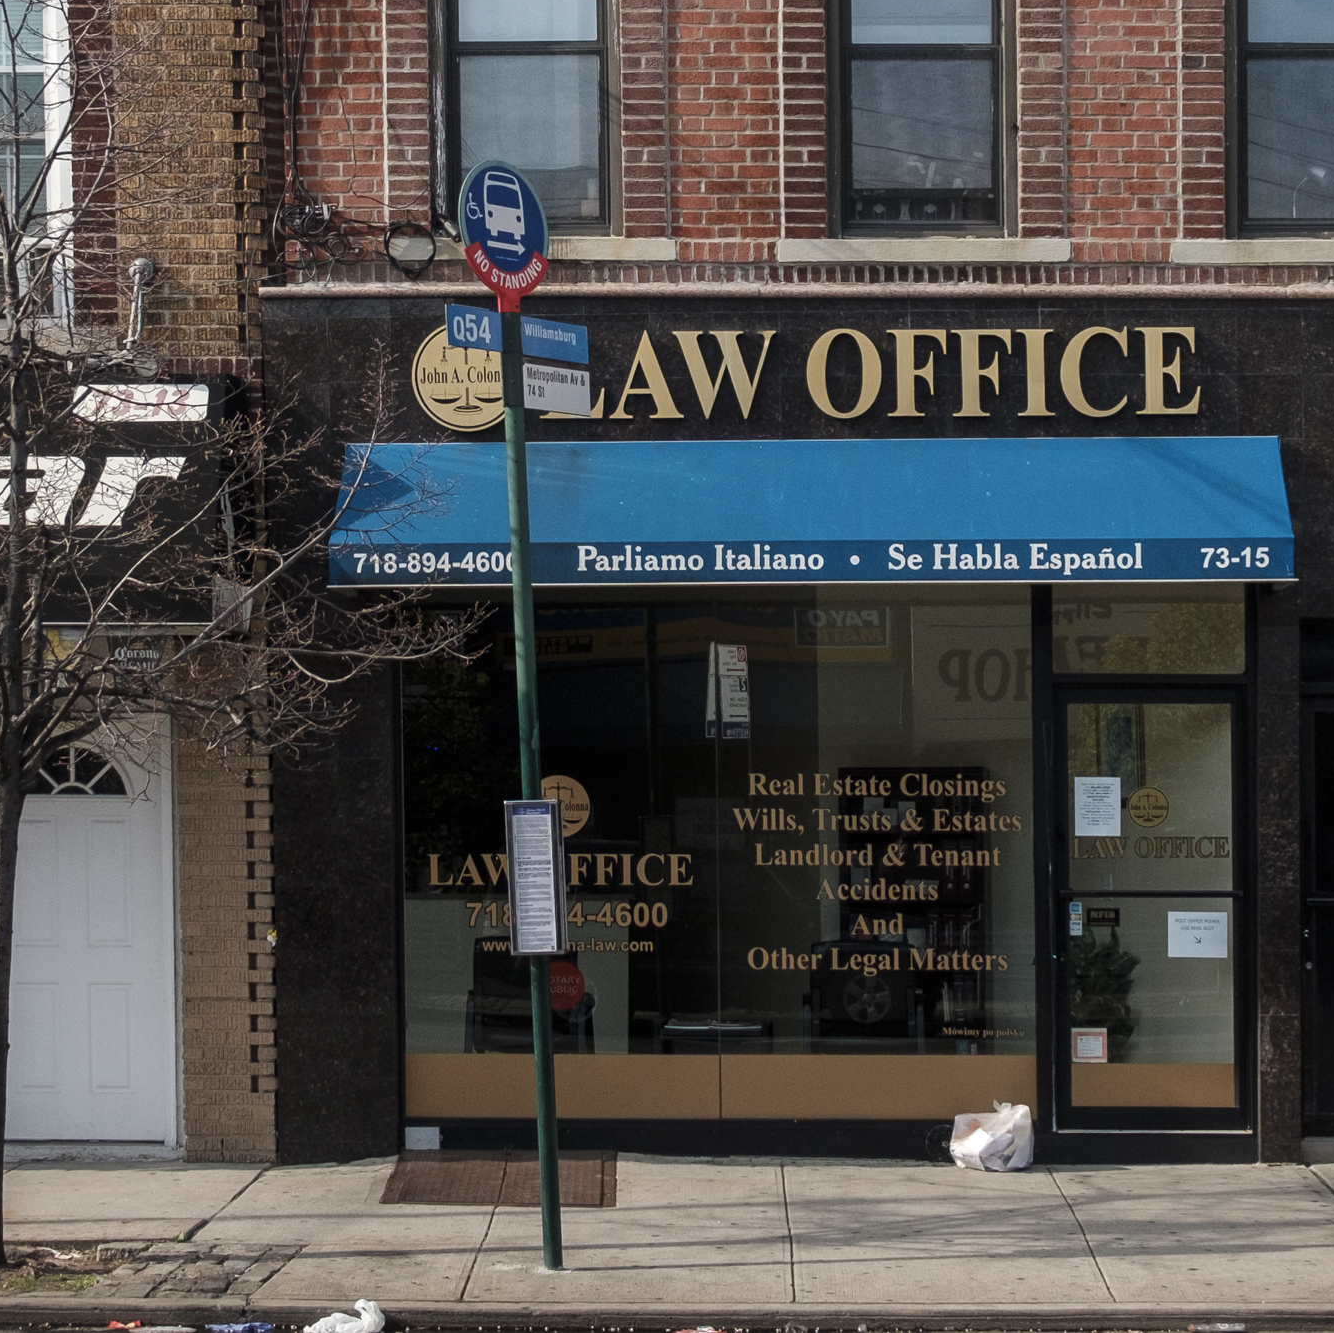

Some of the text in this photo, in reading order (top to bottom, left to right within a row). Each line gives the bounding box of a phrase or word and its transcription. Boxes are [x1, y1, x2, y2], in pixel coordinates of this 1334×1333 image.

[473, 249, 543, 289] NO STANDING
[452, 314, 492, 344] Q54
[523, 322, 577, 346] Williamsburg
[420, 366, 501, 385] John A. Colon
[526, 366, 586, 386] Metropolitan Av &
[805, 324, 1202, 419] OFFICE
[527, 384, 546, 398] 74 St
[577, 545, 704, 573] Parliamo
[714, 544, 825, 571] Italiano
[887, 544, 928, 571] Se
[932, 544, 1021, 571] Habla
[1028, 543, 1144, 575] Español
[1199, 546, 1270, 570] 73-15
[747, 772, 1007, 803] Real Estate Closings
[732, 808, 805, 836] Wills,
[813, 808, 891, 831] Trusts
[900, 808, 924, 832] &
[932, 808, 1023, 832] Estates
[754, 842, 1002, 866] Landlord & Tenant
[1071, 836, 1230, 860] LAW OFFICE
[427, 853, 694, 887] LAW FFICE
[816, 878, 939, 901] Accidents
[466, 902, 669, 928] 7184-4600
[851, 913, 904, 936] And
[482, 937, 654, 953] wwna-law.com
[747, 946, 1009, 976] Other Legal Matters
[549, 975, 581, 985] OTARY
[550, 985, 578, 994] UBLIC
[941, 1026, 980, 1038] Mówimy
[982, 1028, 994, 1038] po
